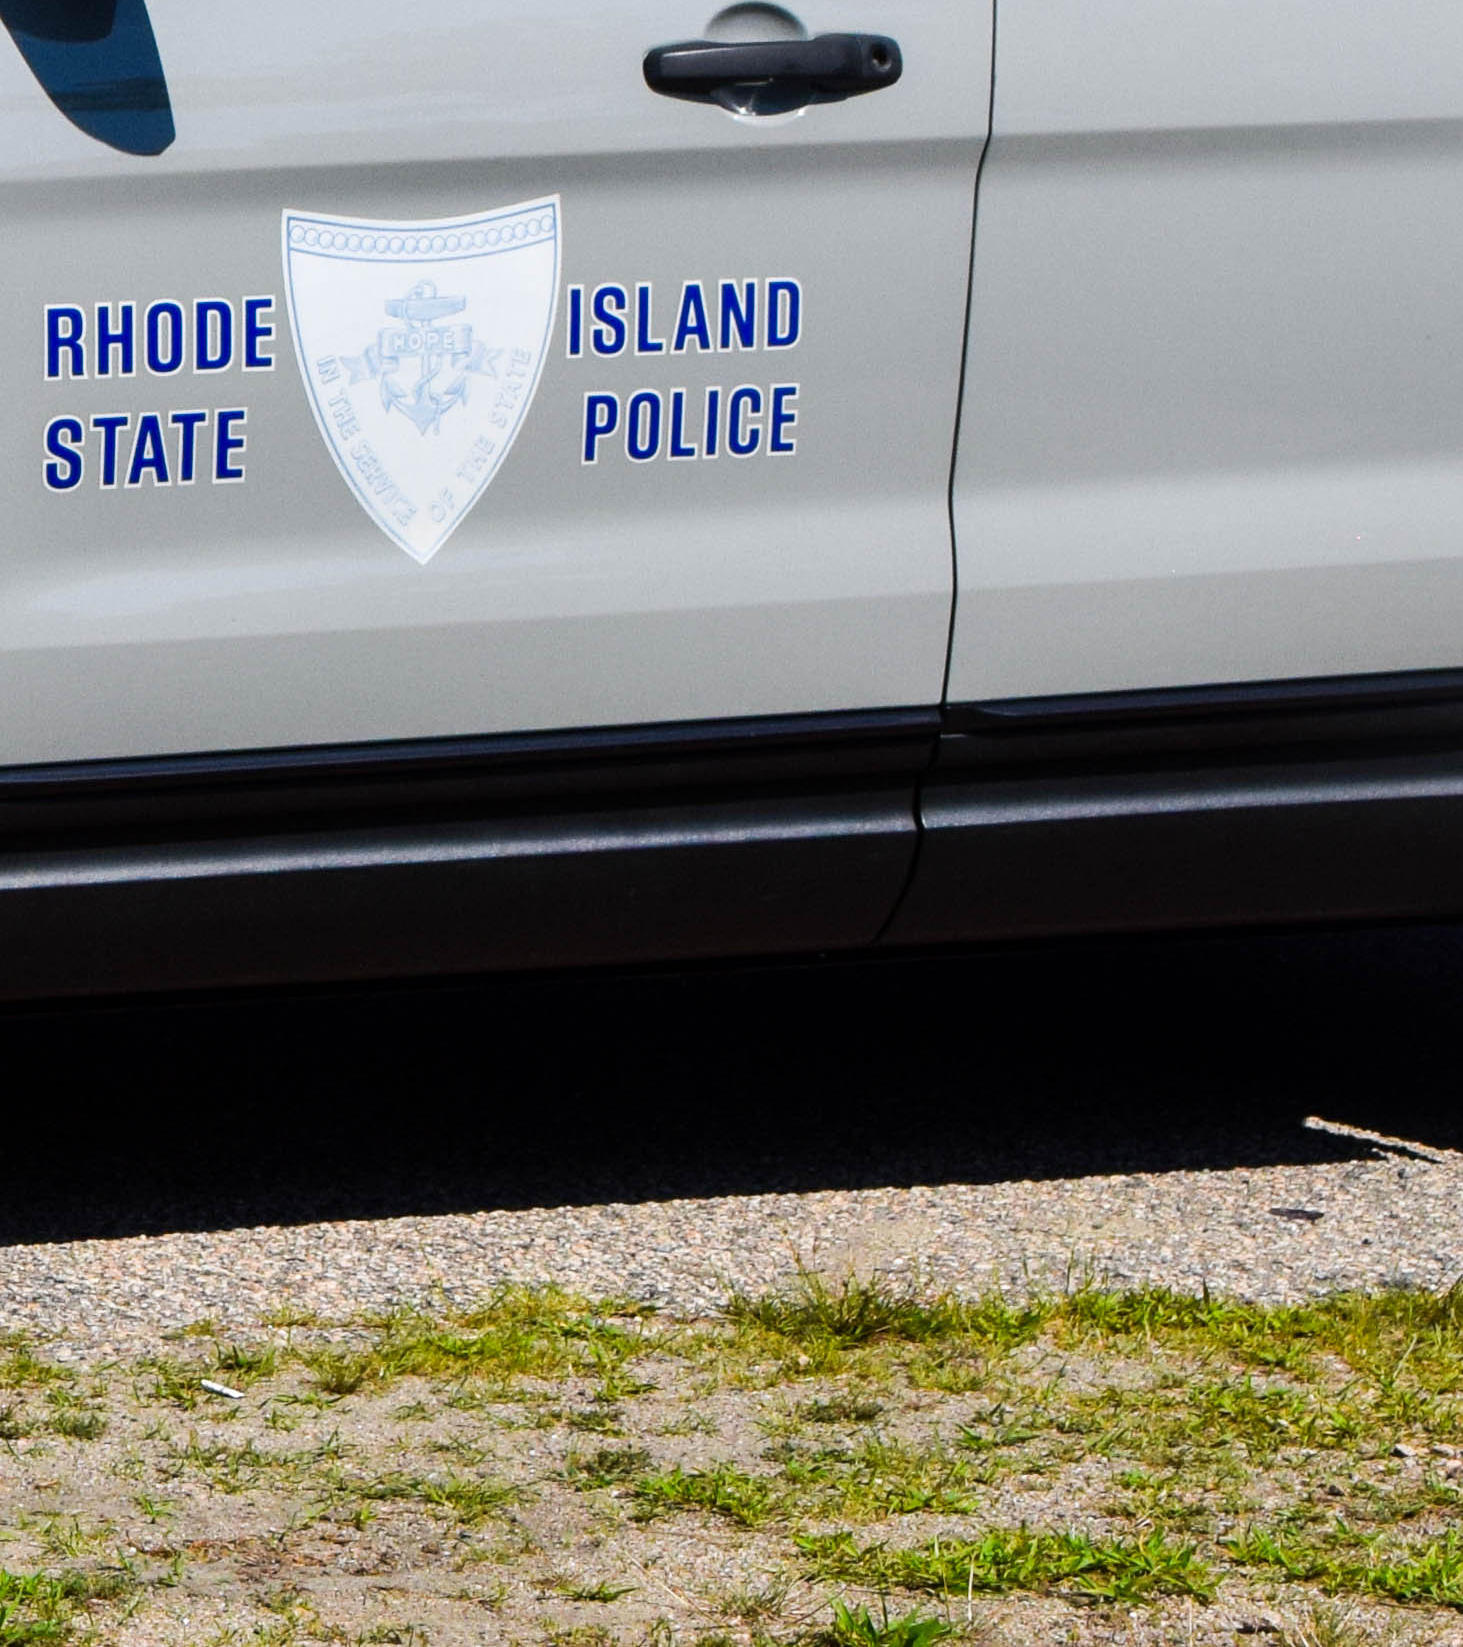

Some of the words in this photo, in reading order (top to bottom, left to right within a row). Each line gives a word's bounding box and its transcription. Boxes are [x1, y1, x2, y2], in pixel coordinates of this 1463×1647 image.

[43, 297, 275, 382] RHODE
[391, 329, 457, 353] HOPE
[567, 277, 803, 361] ISLAND
[316, 355, 342, 385] IN
[490, 348, 532, 430] STATE
[43, 406, 247, 493] STATE
[328, 388, 361, 441] THE
[581, 384, 799, 465] POLICE
[350, 440, 418, 528] SERVICE
[456, 435, 496, 484] THE
[429, 488, 455, 524] OF
